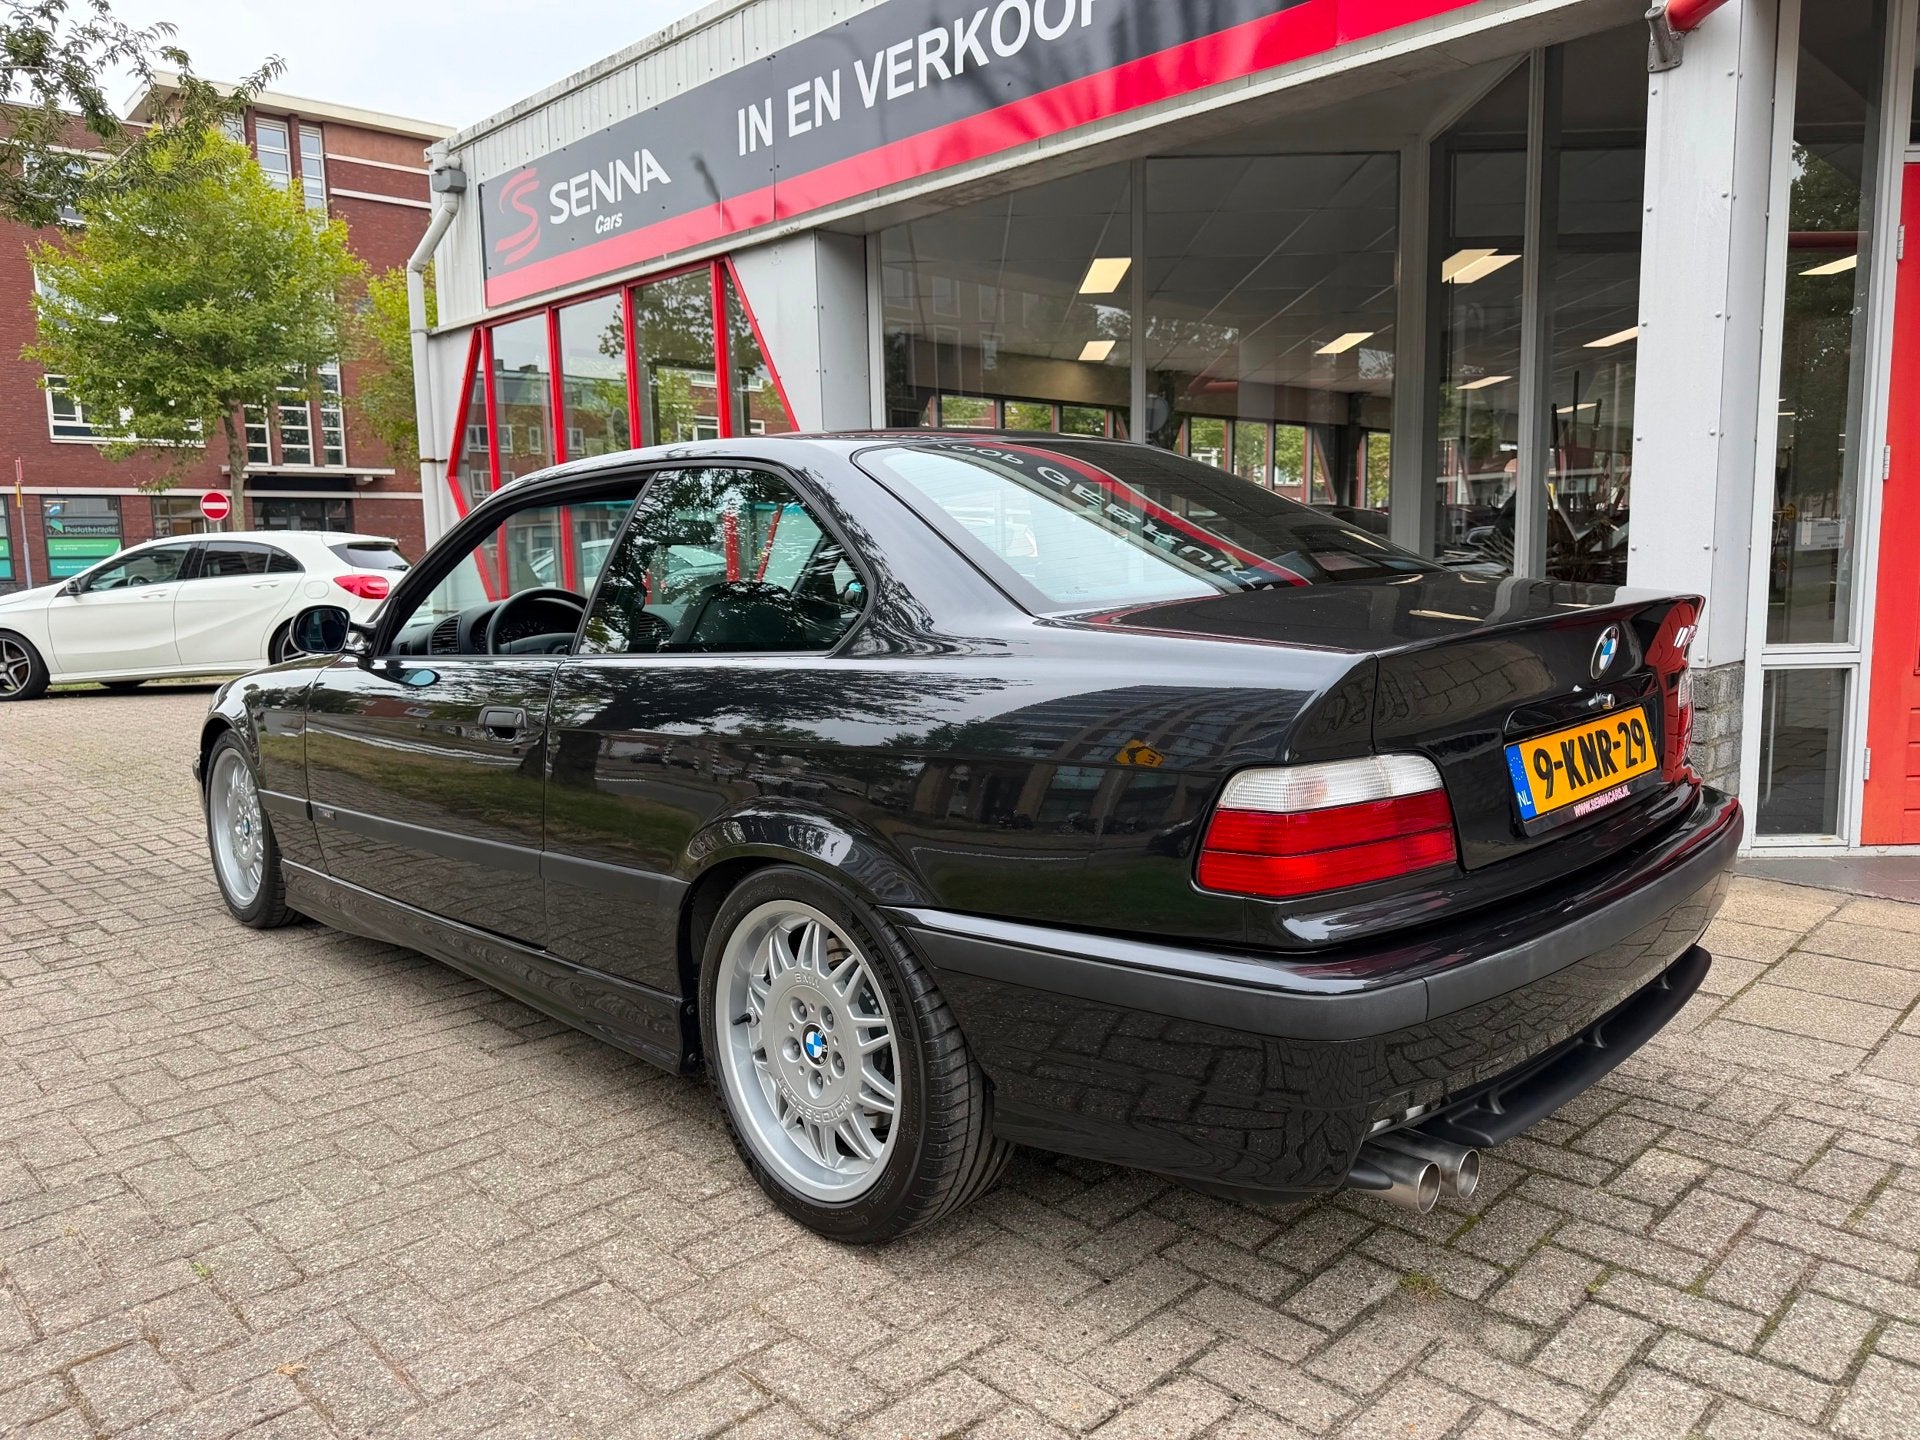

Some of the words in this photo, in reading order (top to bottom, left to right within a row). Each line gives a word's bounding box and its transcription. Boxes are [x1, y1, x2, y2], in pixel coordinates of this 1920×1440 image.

[738, 97, 773, 157] IN
[787, 69, 841, 138] EN
[549, 148, 672, 225] SENNA
[594, 212, 623, 234] Cars
[1533, 717, 1647, 800] 9-KNR-29
[1517, 790, 1532, 807] NL
[794, 971, 821, 989] BMW
[818, 1029, 829, 1064] BMW
[776, 1076, 851, 1123] MOTORSPORT
